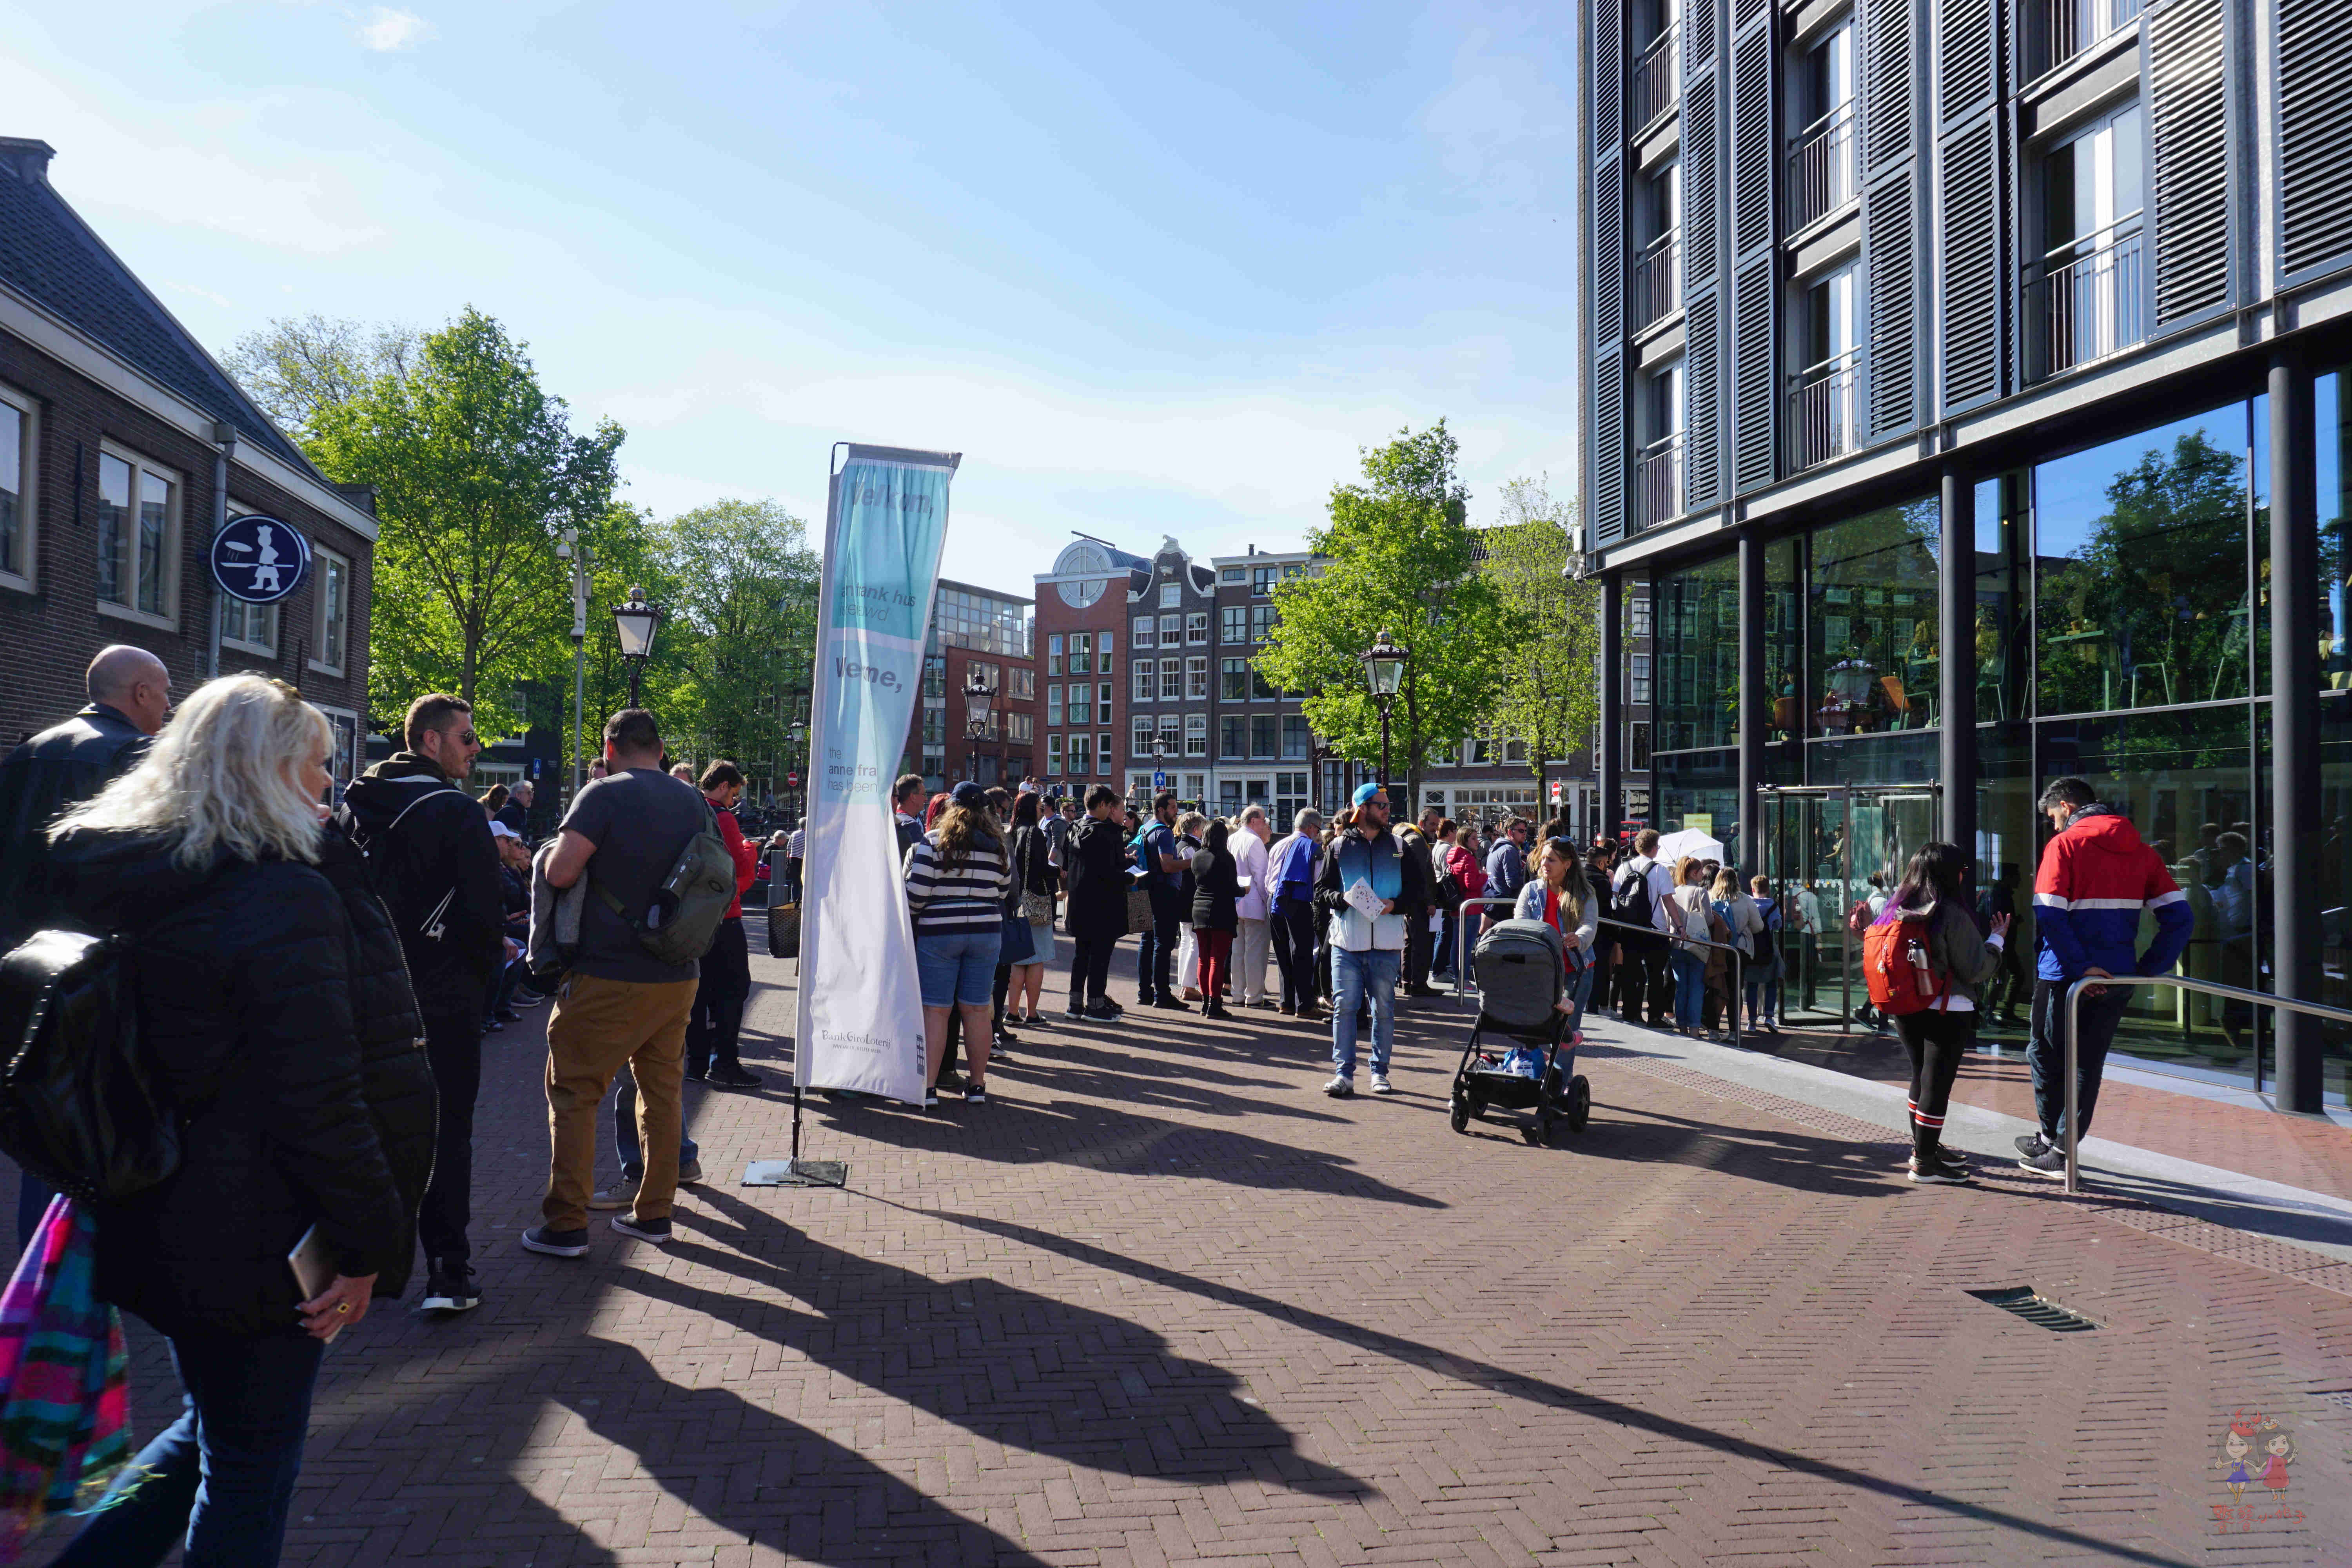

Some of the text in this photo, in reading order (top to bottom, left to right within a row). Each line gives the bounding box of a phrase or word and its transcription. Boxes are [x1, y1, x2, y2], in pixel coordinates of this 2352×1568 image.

[829, 747, 841, 759] the
[829, 764, 877, 777] anne fra
[828, 778, 878, 793] has been
[822, 1029, 891, 1050] BankGiroLoterij
